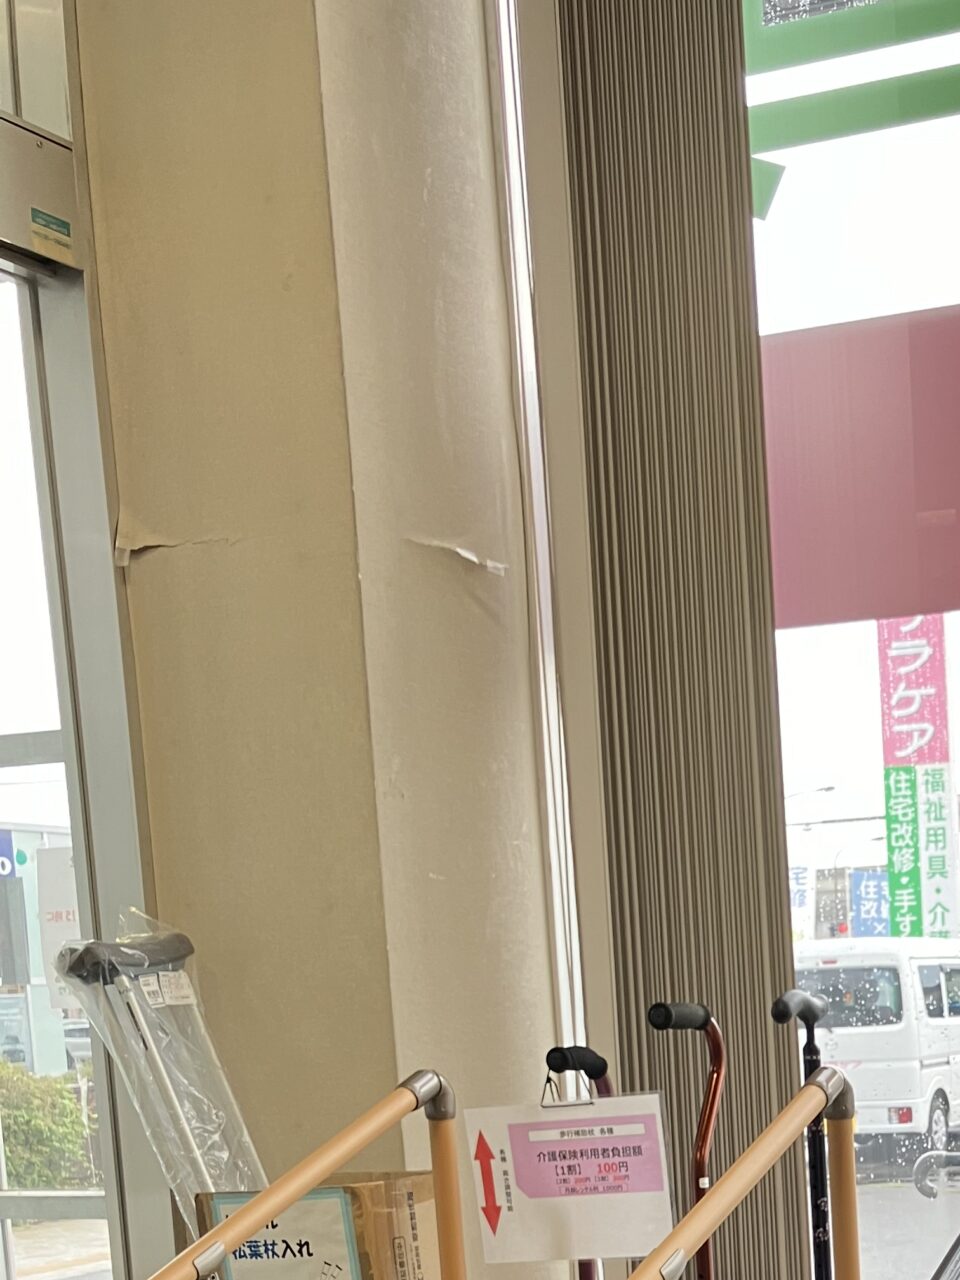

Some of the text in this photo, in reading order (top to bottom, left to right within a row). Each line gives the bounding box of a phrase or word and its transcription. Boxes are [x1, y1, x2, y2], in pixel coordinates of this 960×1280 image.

[922, 768, 950, 938] 福祉用具・介
[537, 1145, 643, 1162] 介護保険利用者負担額
[597, 1161, 629, 1174] 100円
